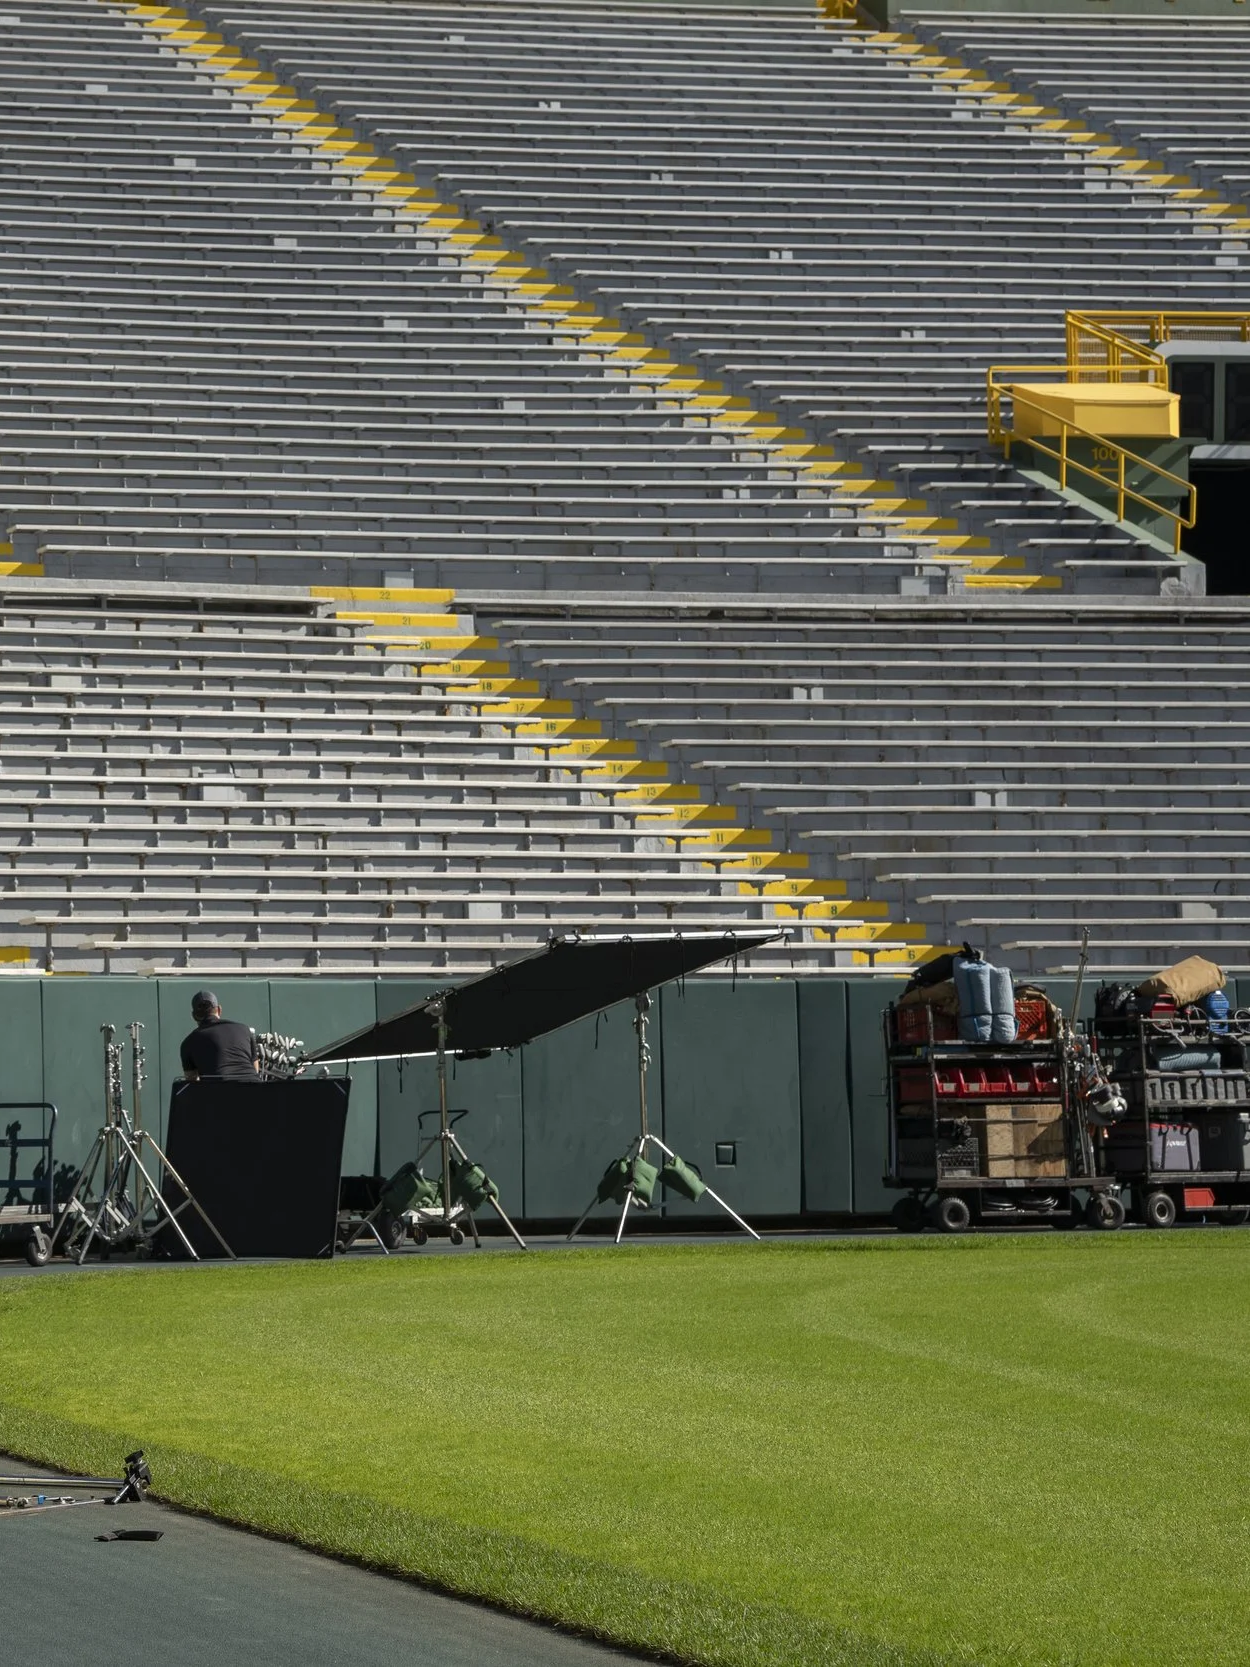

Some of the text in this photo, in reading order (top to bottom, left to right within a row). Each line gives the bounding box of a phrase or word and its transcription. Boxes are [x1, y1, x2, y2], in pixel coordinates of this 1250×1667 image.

[1091, 448, 1118, 460] 100
[380, 591, 390, 600] 22
[402, 616, 410, 625] 21
[420, 641, 431, 650] 20
[452, 664, 461, 672] 19
[516, 704, 524, 712] 17
[582, 744, 590, 752] 15
[613, 764, 622, 773] 14
[647, 787, 656, 796] 13
[681, 809, 689, 818] 12
[717, 833, 724, 842] 11
[752, 856, 761, 866] 10
[791, 884, 798, 893] 9
[831, 905, 838, 915] 8
[870, 928, 876, 938] 7
[908, 950, 915, 960] 6
